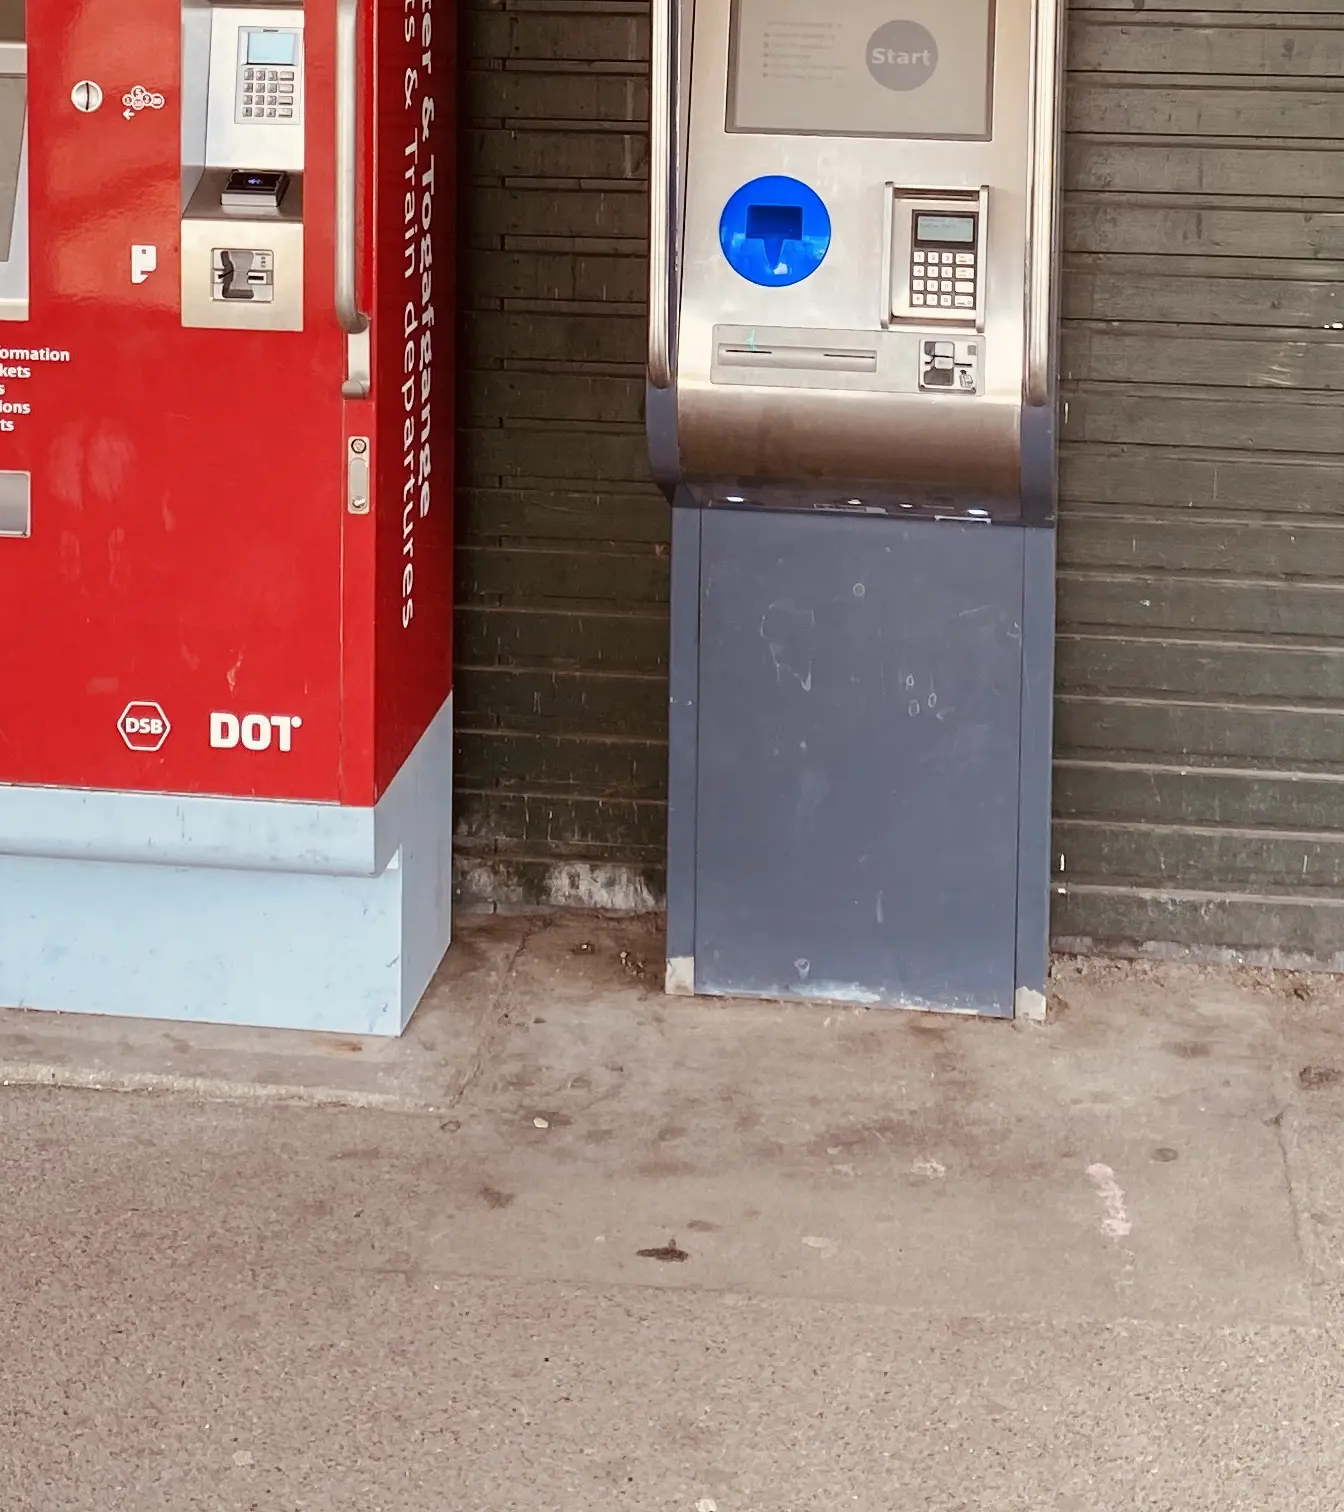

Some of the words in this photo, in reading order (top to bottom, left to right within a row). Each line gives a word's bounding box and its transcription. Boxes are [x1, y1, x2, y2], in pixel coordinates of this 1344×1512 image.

[871, 47, 932, 67] Start
[403, 67, 418, 111] &
[422, 95, 435, 142] &
[403, 127, 419, 279] Train
[420, 154, 435, 518] Togafgange
[401, 301, 419, 629] departures
[125, 717, 164, 735] DSB
[210, 712, 302, 752] DOT
